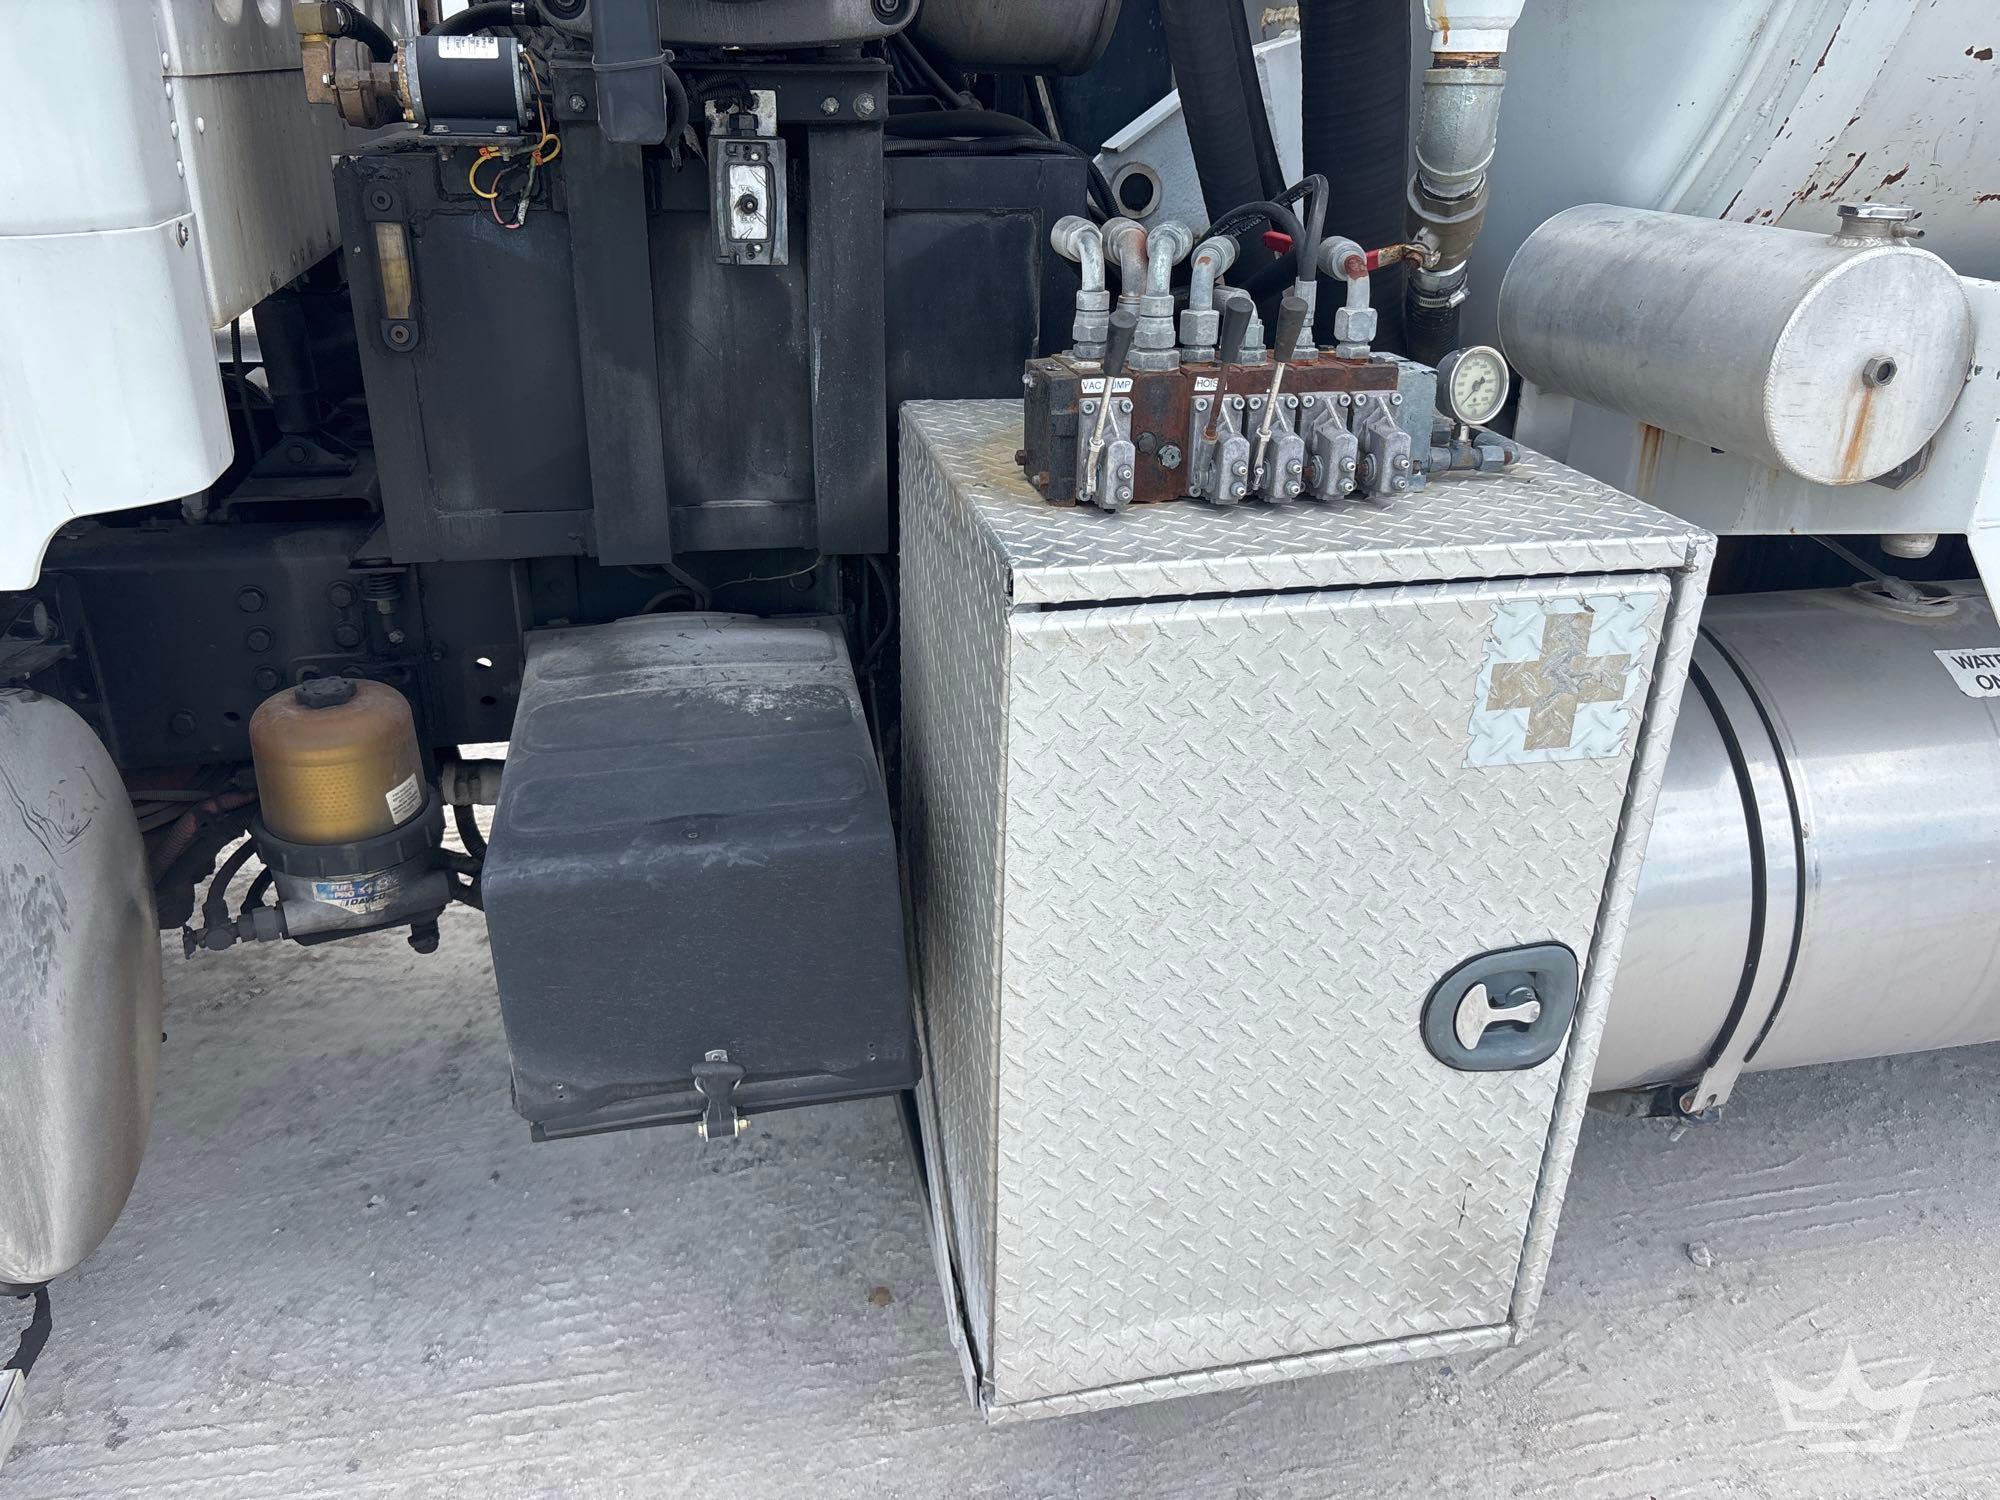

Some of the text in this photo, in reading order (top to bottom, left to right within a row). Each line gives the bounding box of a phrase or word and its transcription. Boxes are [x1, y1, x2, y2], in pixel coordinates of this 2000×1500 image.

[1082, 380, 1131, 390] VAC UMP
[1196, 378, 1218, 389] HOIS
[330, 883, 355, 892] FUEL
[334, 890, 355, 898] PRO
[349, 893, 387, 906] DAVCO
